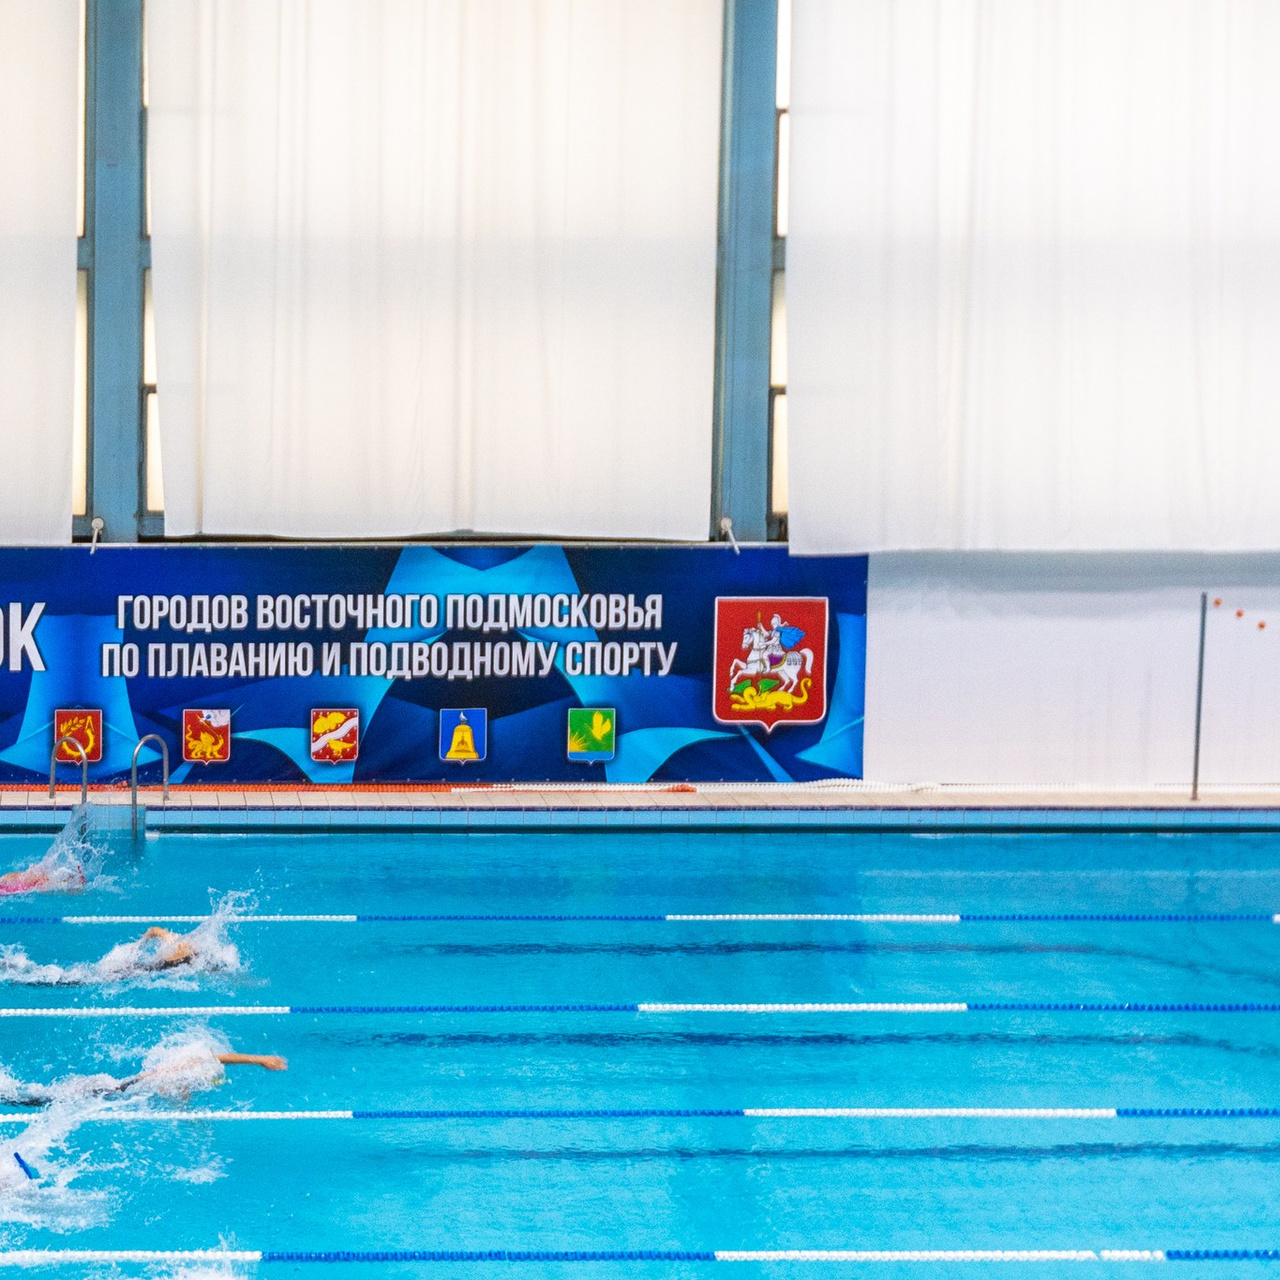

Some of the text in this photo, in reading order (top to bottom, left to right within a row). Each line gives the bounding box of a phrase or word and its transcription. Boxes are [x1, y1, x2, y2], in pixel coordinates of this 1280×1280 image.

[117, 593, 663, 633] ГОРОДОВ ВОСТОЧНОГО ПОДМОСКОВЬЯ
[101, 641, 678, 680] ПО ПЛАВАНИЮ И ПОДВОДНОМУ СПОРТУ
